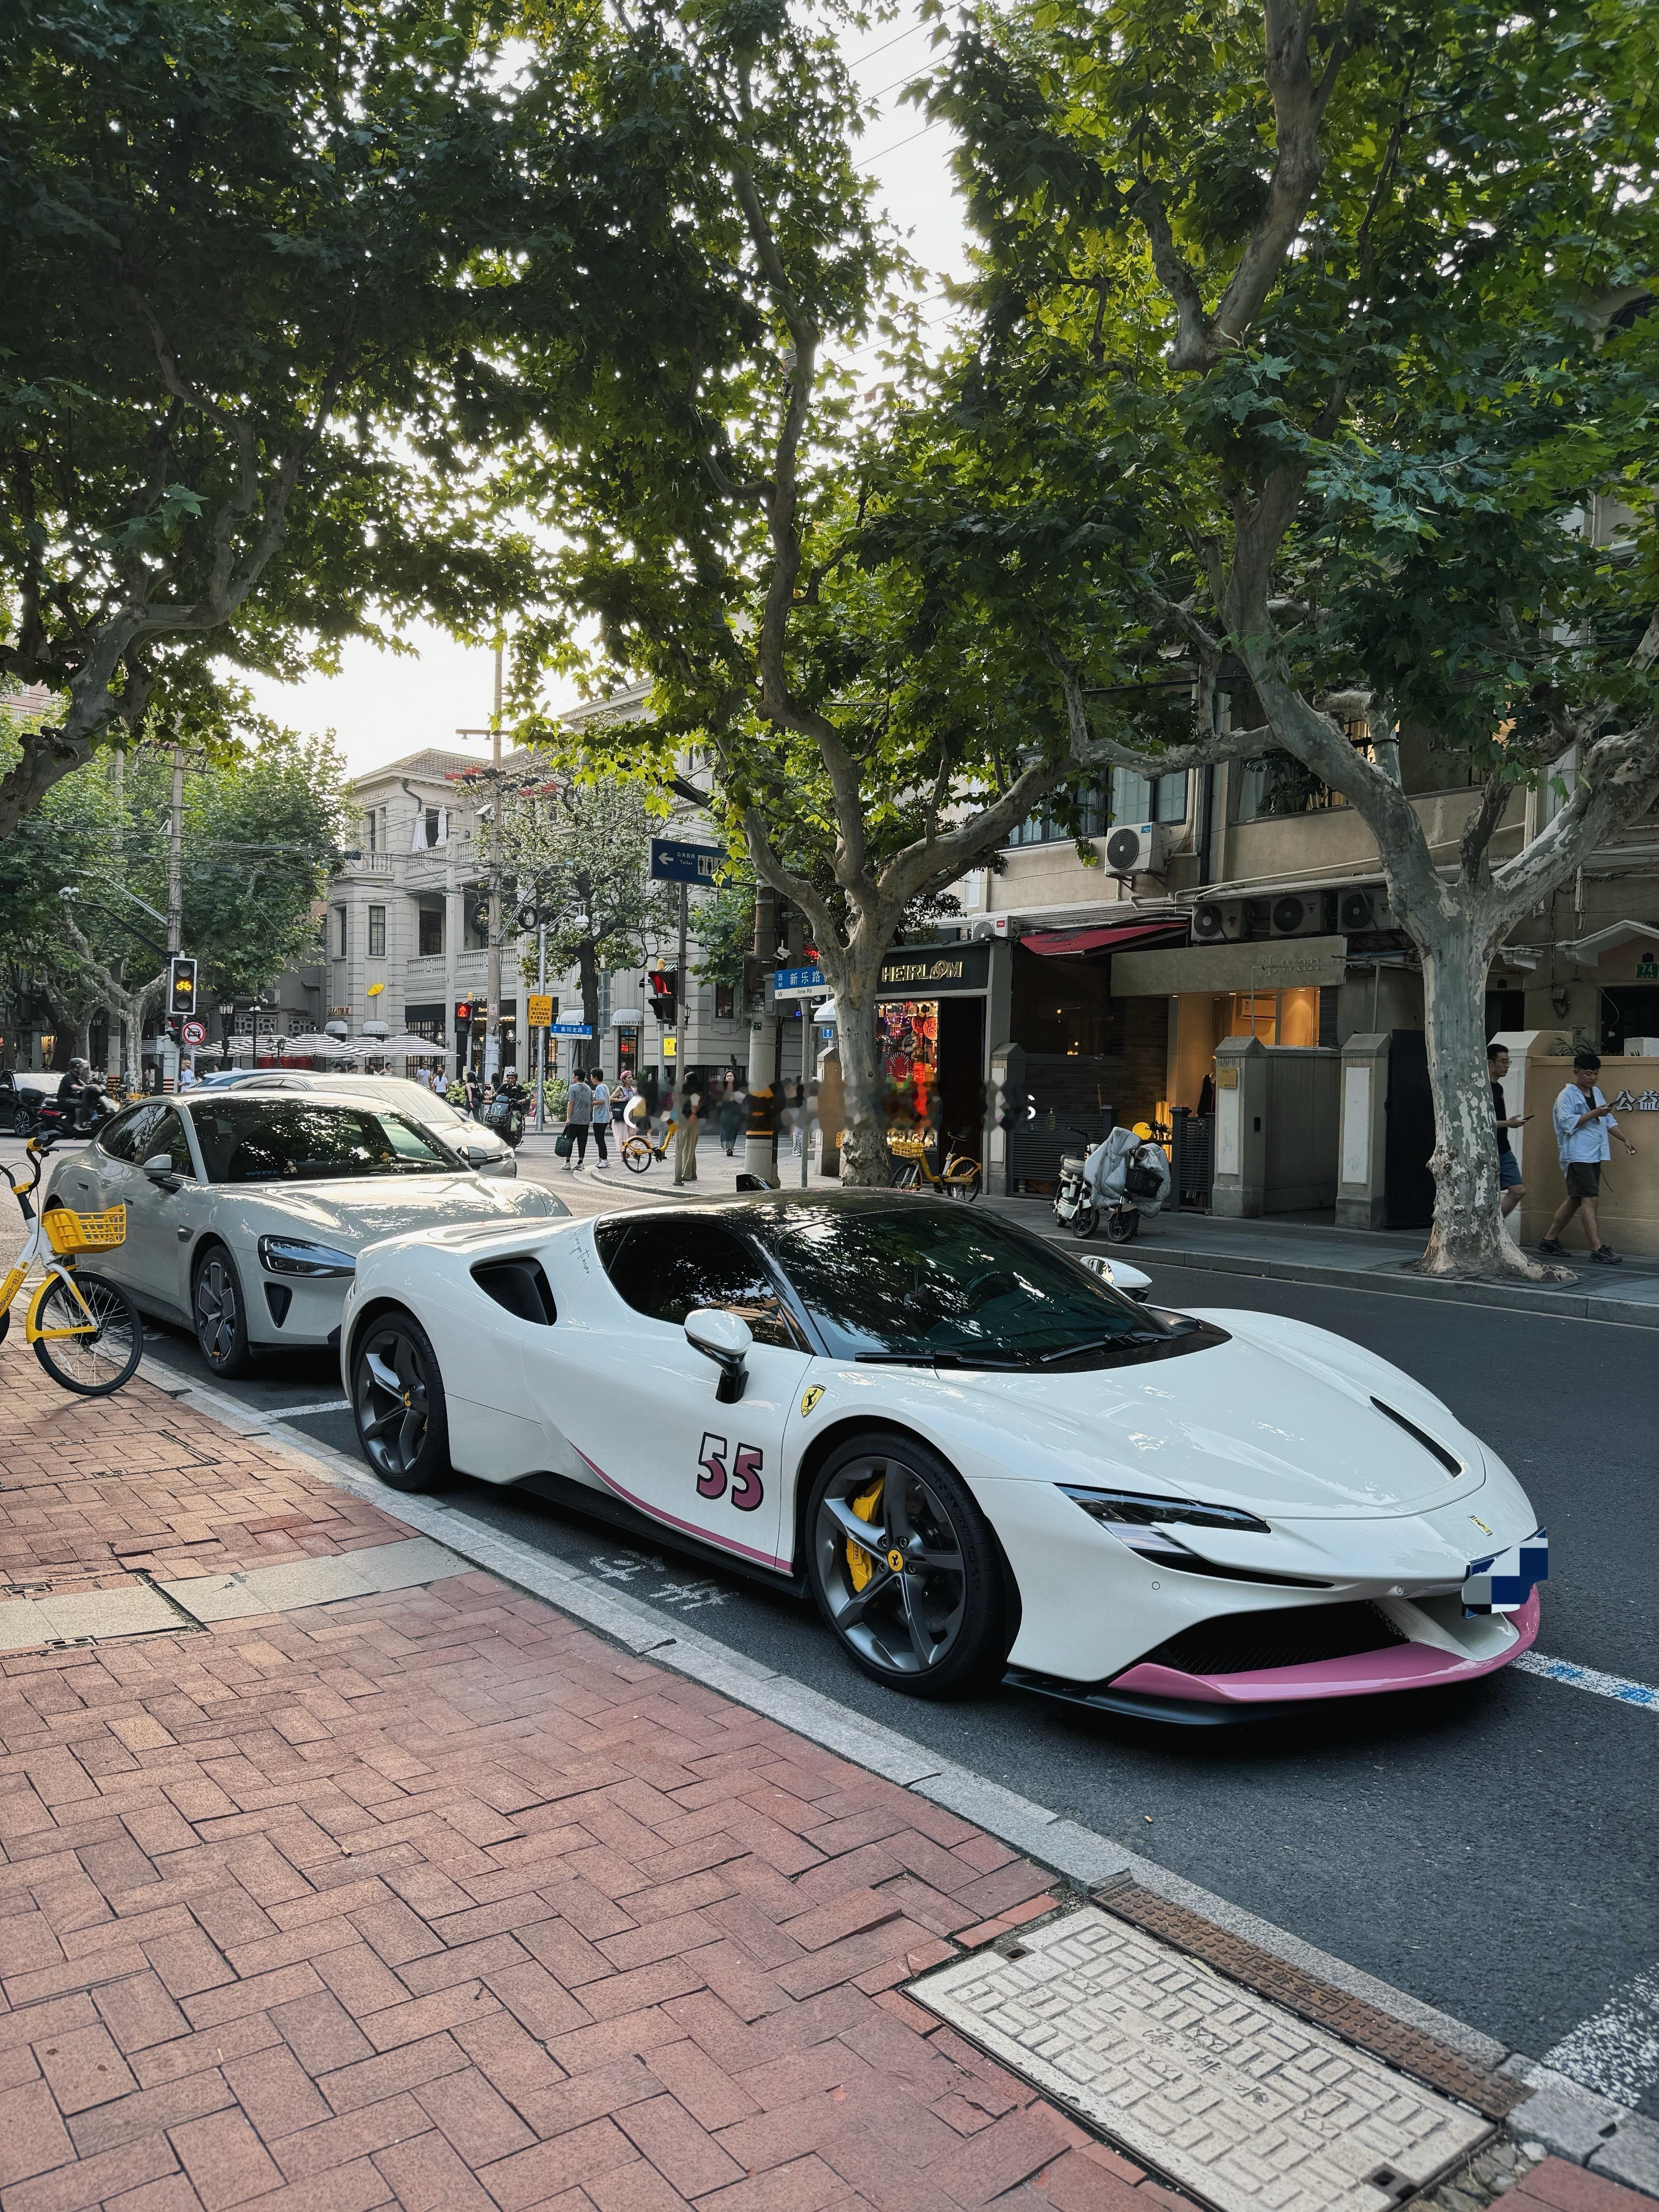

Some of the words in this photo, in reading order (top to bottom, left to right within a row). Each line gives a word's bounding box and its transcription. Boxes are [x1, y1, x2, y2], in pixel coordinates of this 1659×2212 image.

[790, 970, 820, 985] 新乐路
[881, 959, 962, 982] HEIRLOOM
[1642, 964, 1653, 973] 74
[1616, 1089, 1659, 1112] 公益
[696, 1431, 764, 1512] 55
